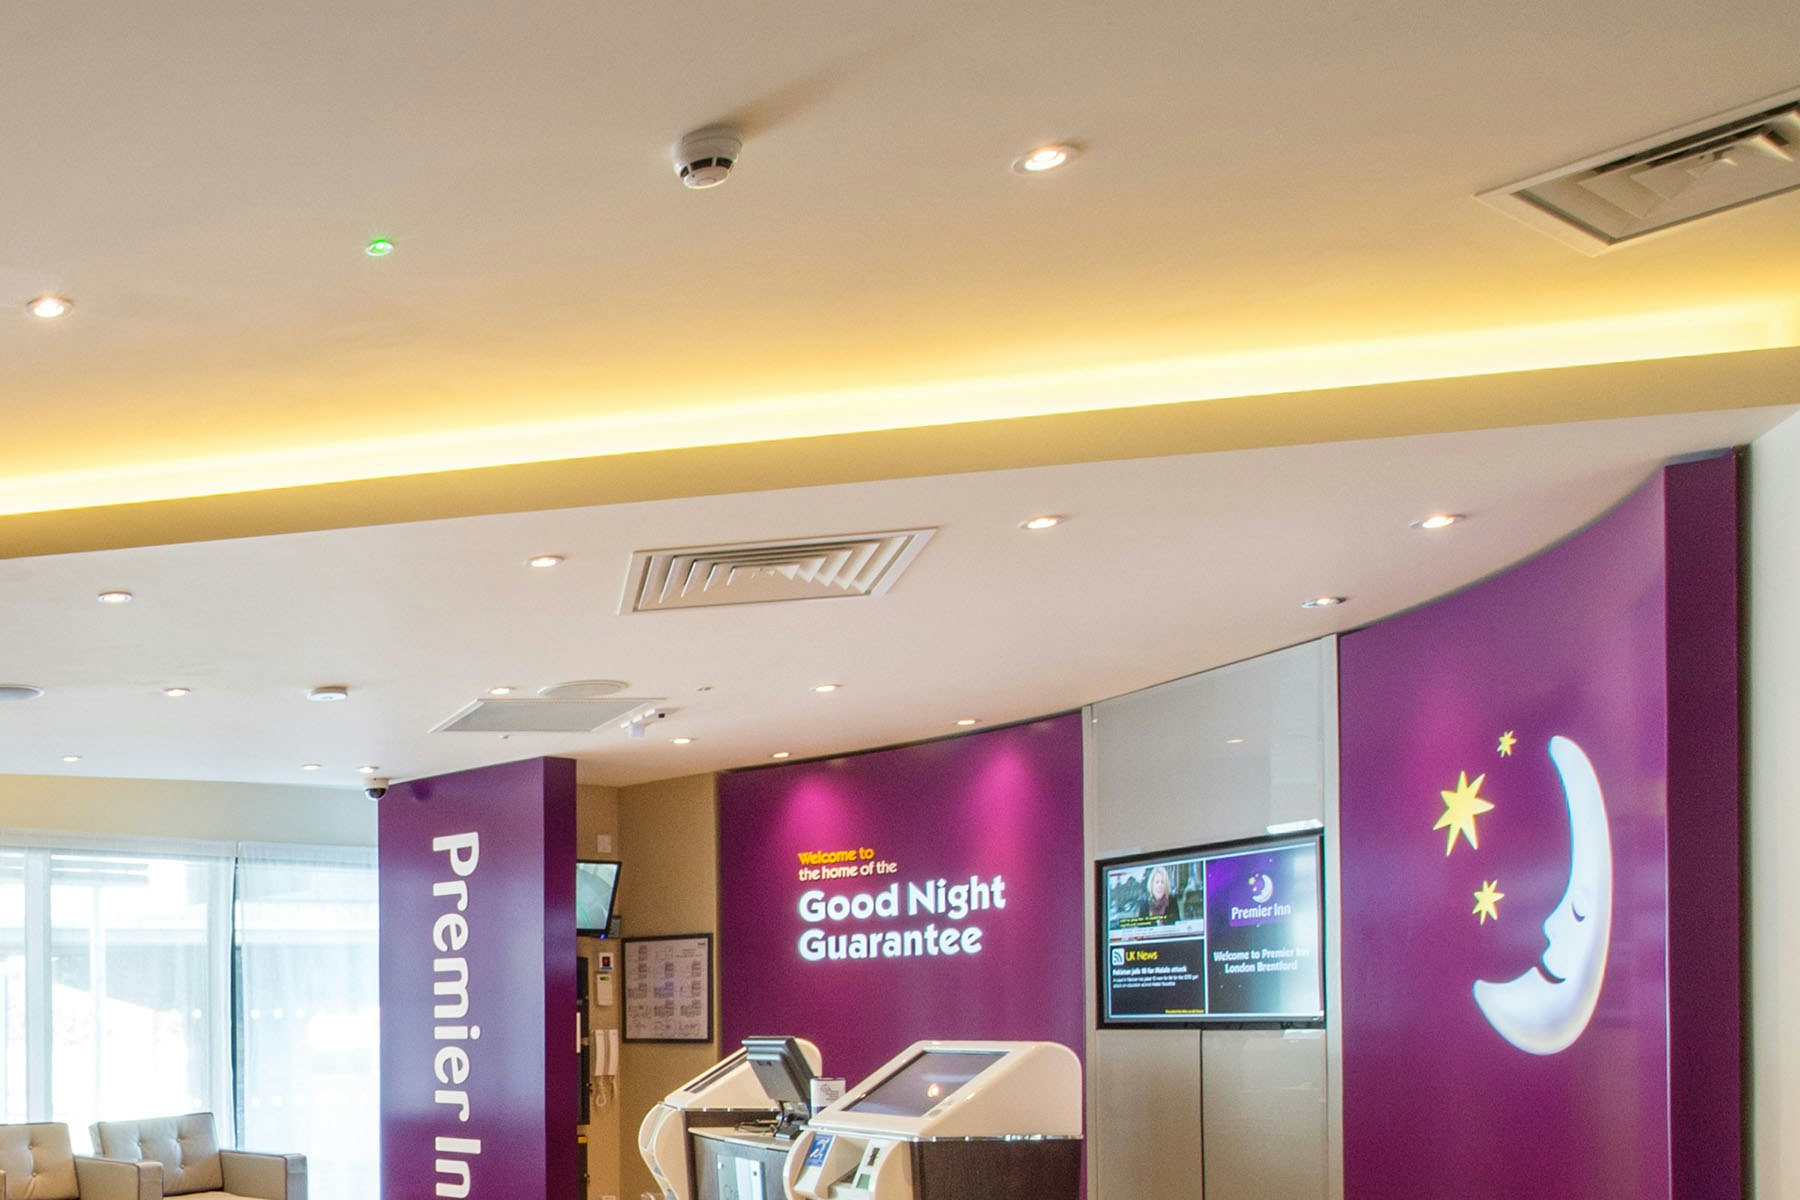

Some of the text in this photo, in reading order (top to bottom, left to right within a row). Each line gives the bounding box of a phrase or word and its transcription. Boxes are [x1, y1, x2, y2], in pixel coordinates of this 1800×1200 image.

[798, 847, 875, 865] Welcome to
[798, 860, 898, 881] the home of the
[798, 875, 1006, 922] Good Night
[1231, 903, 1291, 920] Premier Inn
[798, 923, 983, 961] Guarantee
[1213, 950, 1250, 962] Welcome
[1251, 949, 1260, 960] to
[1262, 947, 1294, 959] Premier
[1224, 960, 1299, 974] London Brentford
[432, 831, 481, 1123] Premier
